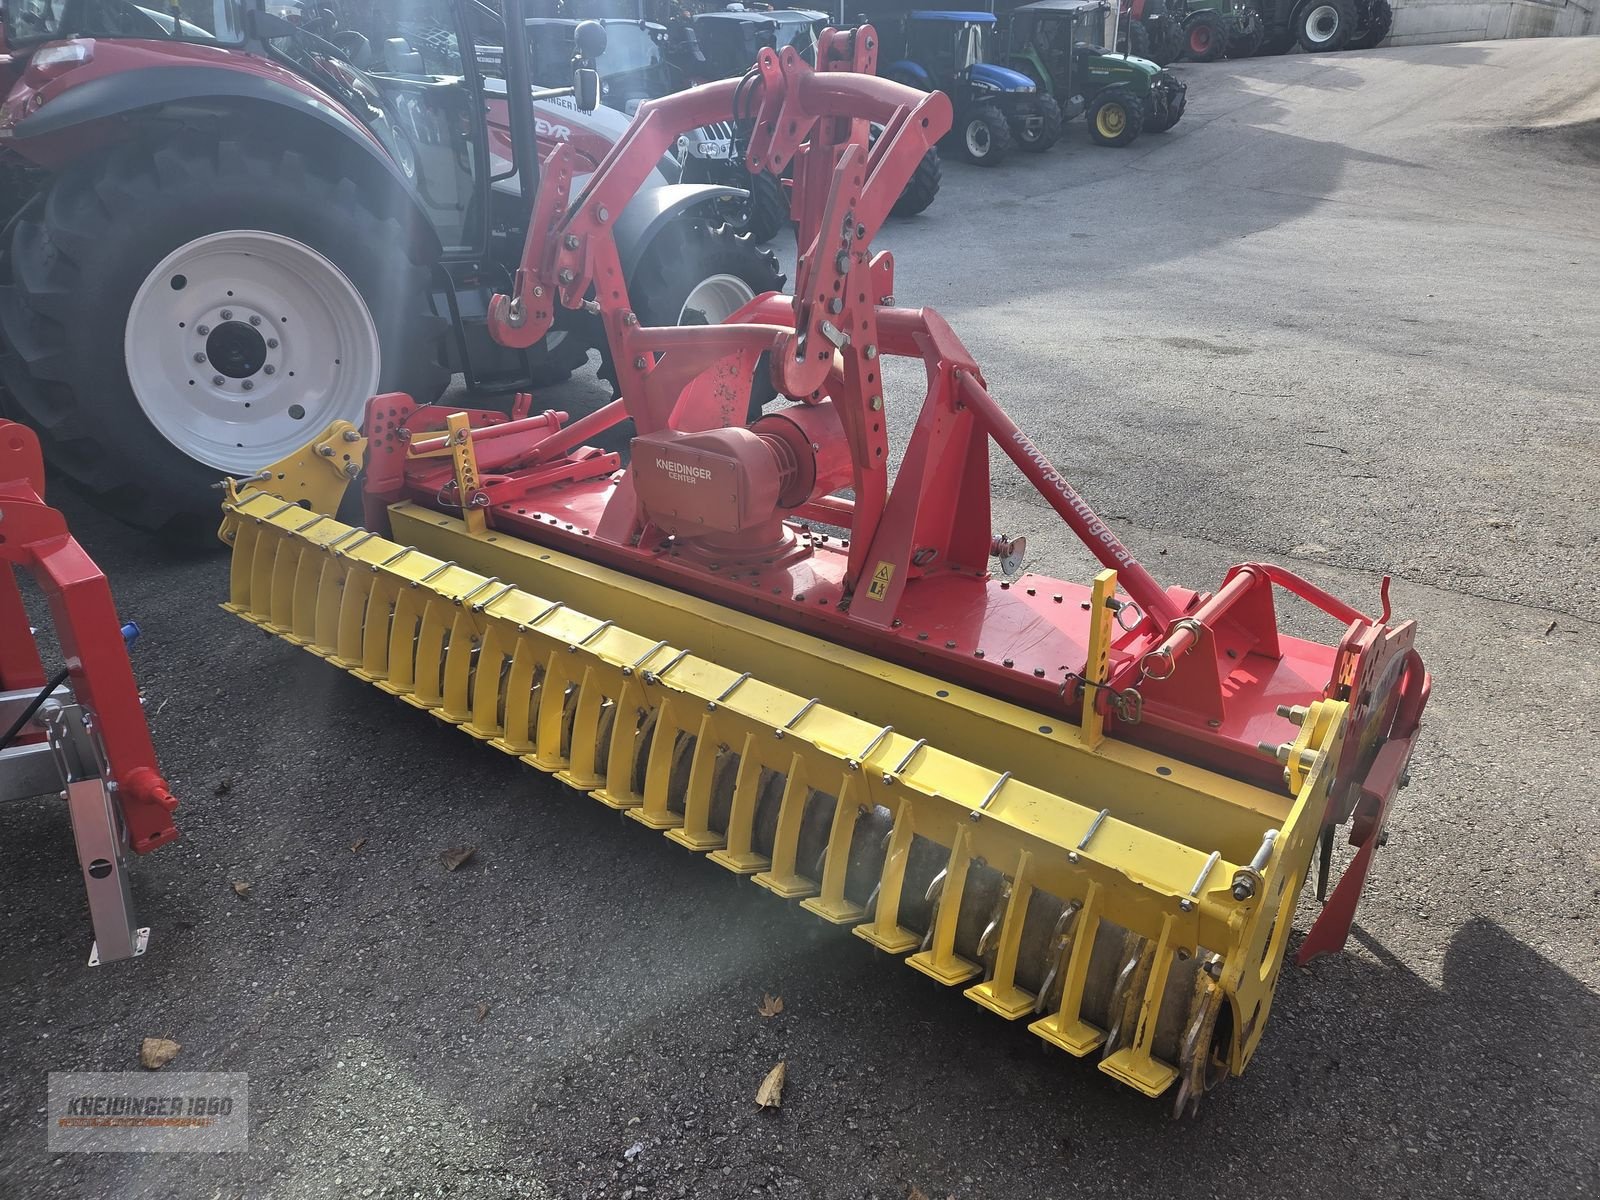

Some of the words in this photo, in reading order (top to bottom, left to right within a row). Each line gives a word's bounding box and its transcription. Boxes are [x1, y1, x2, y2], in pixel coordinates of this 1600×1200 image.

[535, 117, 570, 141] EYR
[656, 458, 711, 480] KNEIDINGER
[668, 471, 696, 484] CENTER
